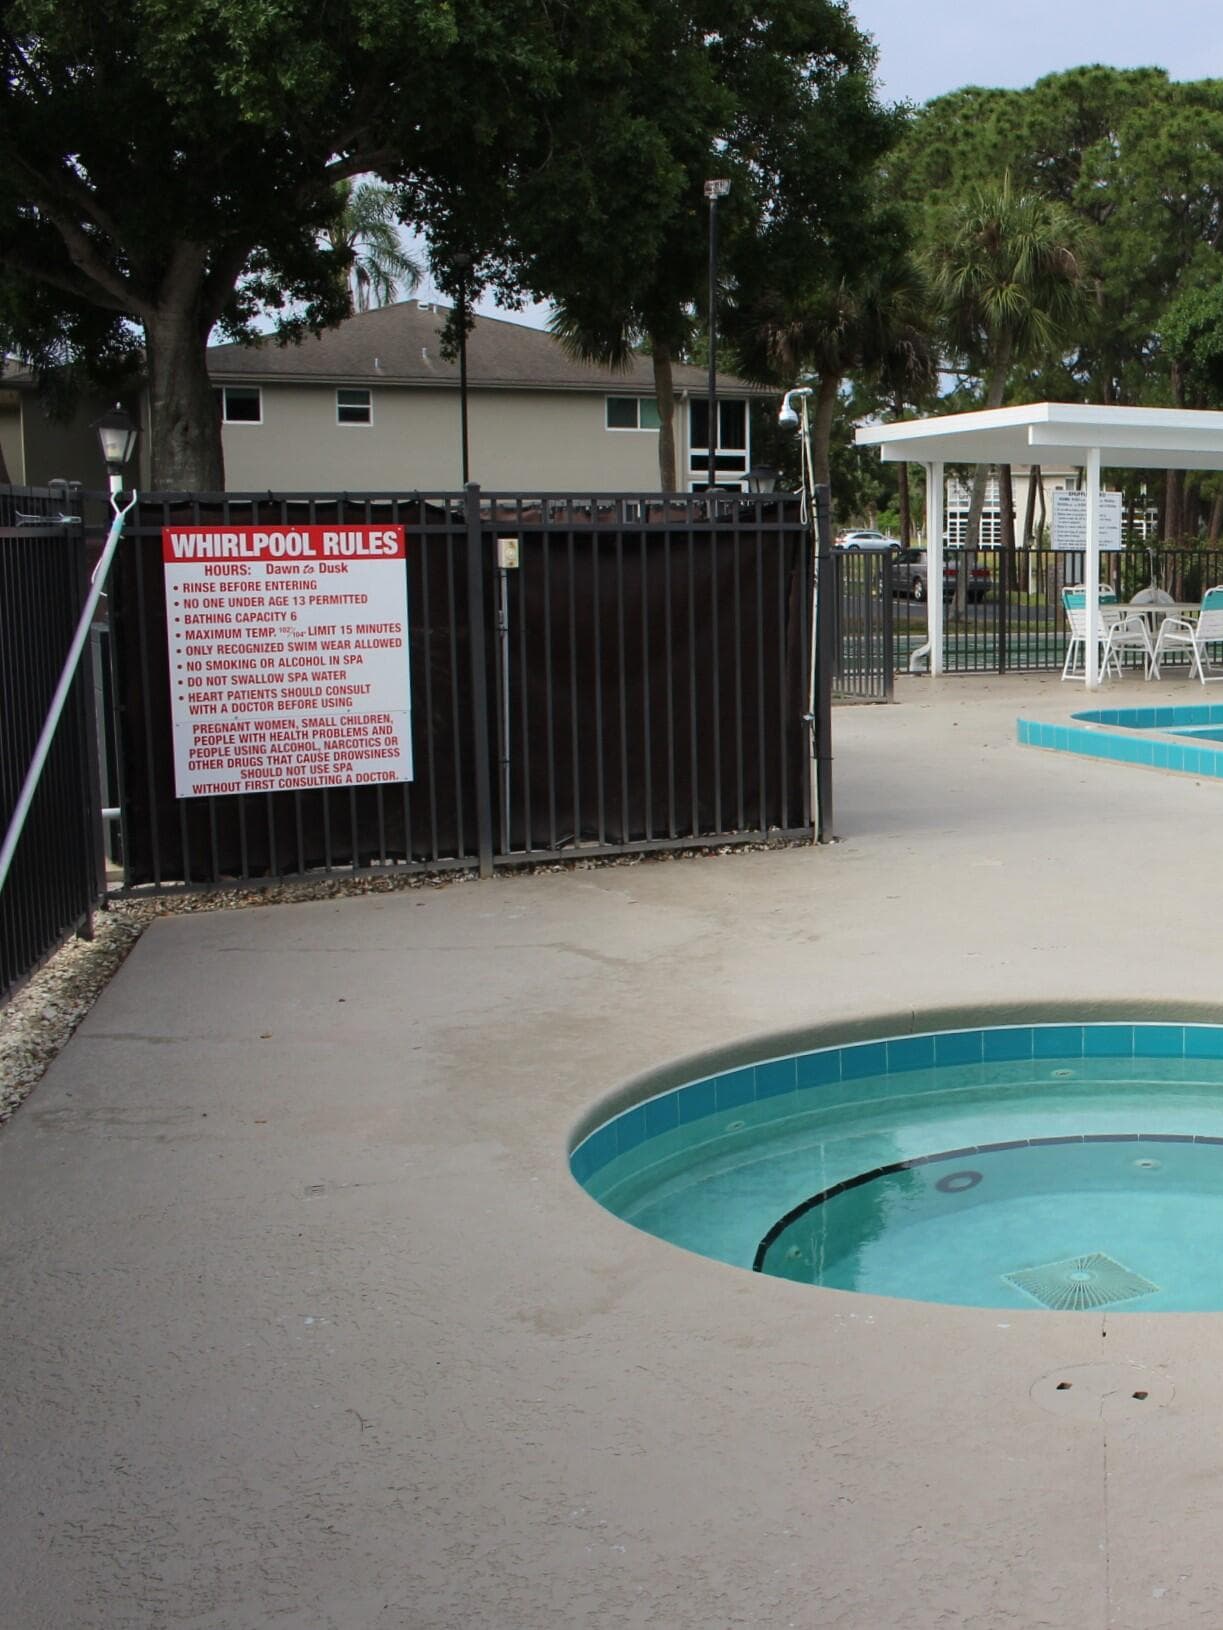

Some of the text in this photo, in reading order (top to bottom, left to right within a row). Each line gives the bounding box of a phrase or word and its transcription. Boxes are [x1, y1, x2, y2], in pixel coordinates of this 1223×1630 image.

[171, 531, 398, 558] WHIRLPOOL RULES
[204, 562, 348, 576] HOURS: Dawn to Dusk
[183, 579, 317, 593] RINSE BEFORE ENTERING
[183, 594, 368, 609] NO ONE UNDER AGE 13 PERMITTED
[184, 611, 297, 624] BATHING CAPACITY 6
[185, 628, 242, 640] MAXIMUM
[245, 627, 276, 638] TEMP.
[308, 625, 336, 636] LIMIT
[340, 624, 353, 635] 15
[356, 622, 401, 634] MINUTES
[185, 637, 402, 656] ONLY RECOGNIZED SWIM WEAR ALLOWED
[186, 654, 363, 672] NO SMOKING OR ALCOHOL IN SPA
[187, 670, 346, 687] DO NOT SWALLOW SPA WATER
[188, 684, 371, 703] HEART PATIENTS SHOULD CONSULT
[189, 697, 353, 715] WITH A DOCTOR BEFORE USING
[192, 713, 393, 734] PREGNANT WOMEN, SMALL CHILDREN,
[194, 725, 393, 746] PEOPLE WITH HEALTH PROBLEMS AND
[189, 736, 398, 759] PEOPLE USING ALCOHOL, NARCOTICS OR
[188, 747, 400, 771] OTHER DRUGS THAT CAUSE DROWSINESS
[240, 762, 353, 779] SHOULD NOT USE SPA
[192, 770, 399, 794] WITHOUT FIRST CONSULTING A DOCTOR.
